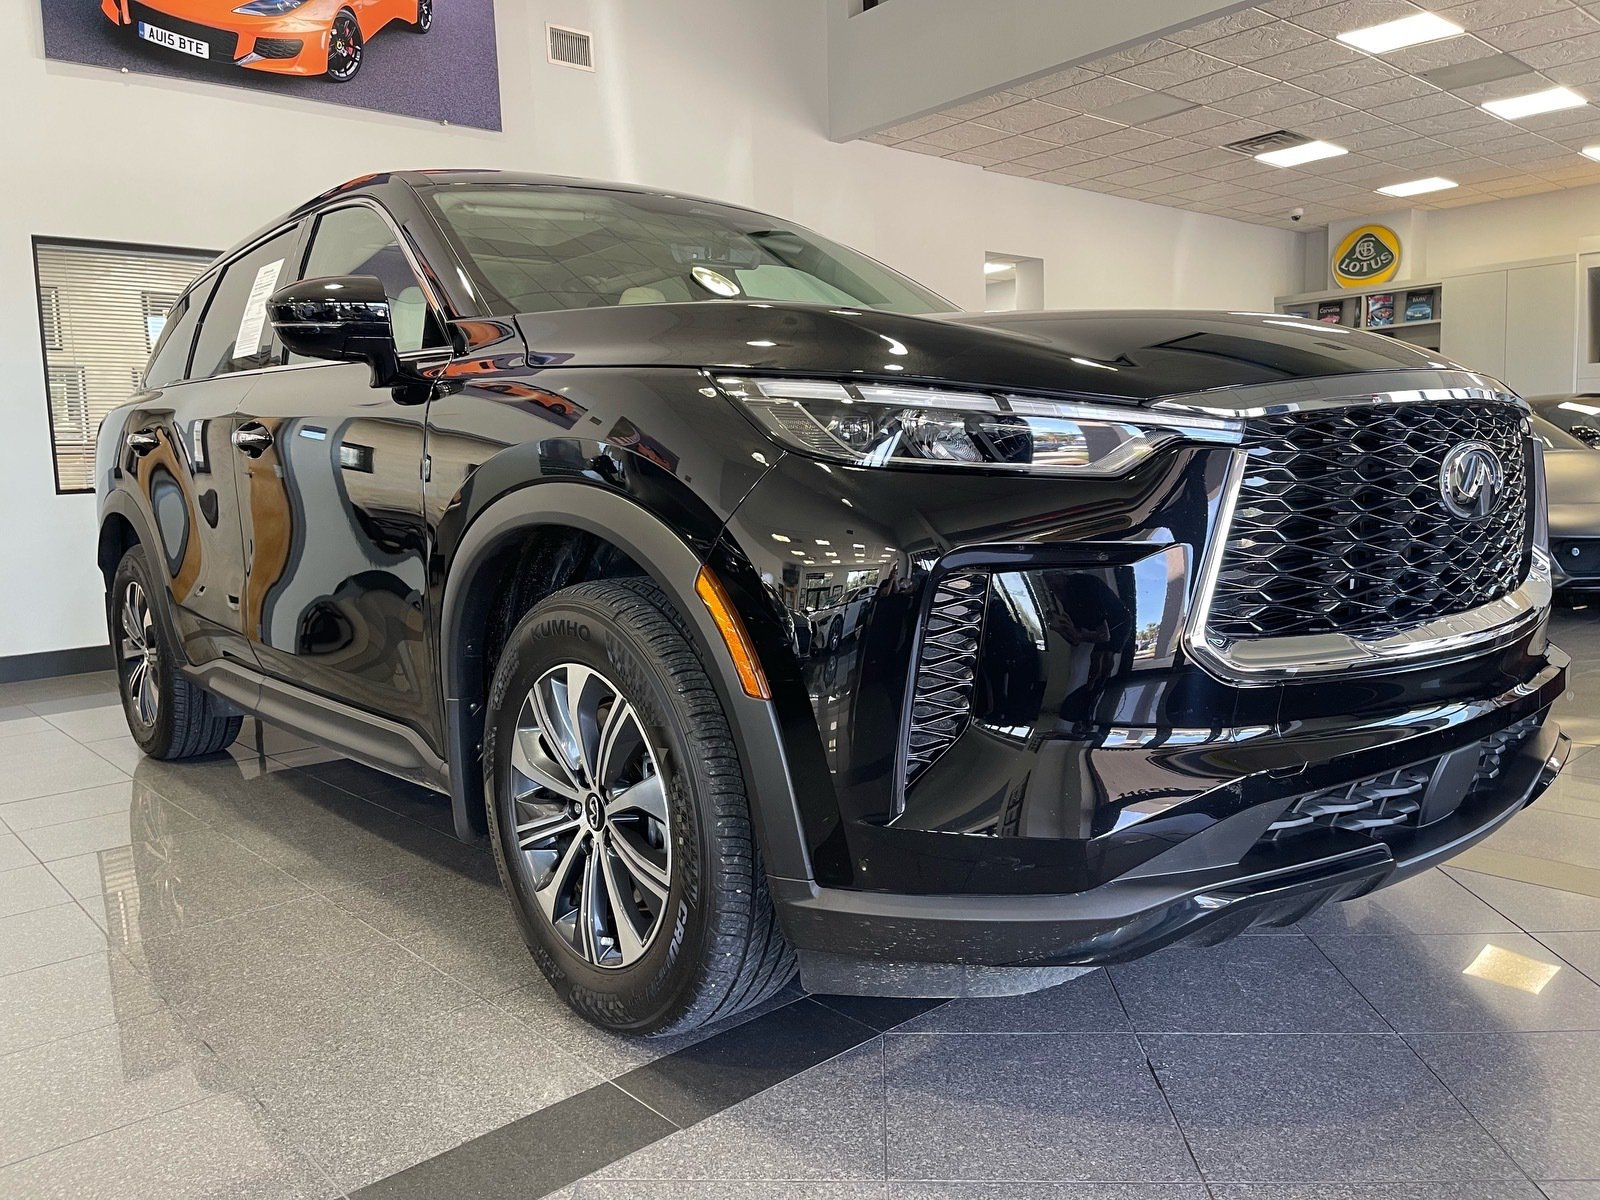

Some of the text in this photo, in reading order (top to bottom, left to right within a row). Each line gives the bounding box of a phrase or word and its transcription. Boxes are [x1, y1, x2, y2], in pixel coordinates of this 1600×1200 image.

[148, 27, 204, 55] AU15 BTE
[1340, 252, 1393, 273] LOTUS
[530, 619, 592, 642] KUMHO
